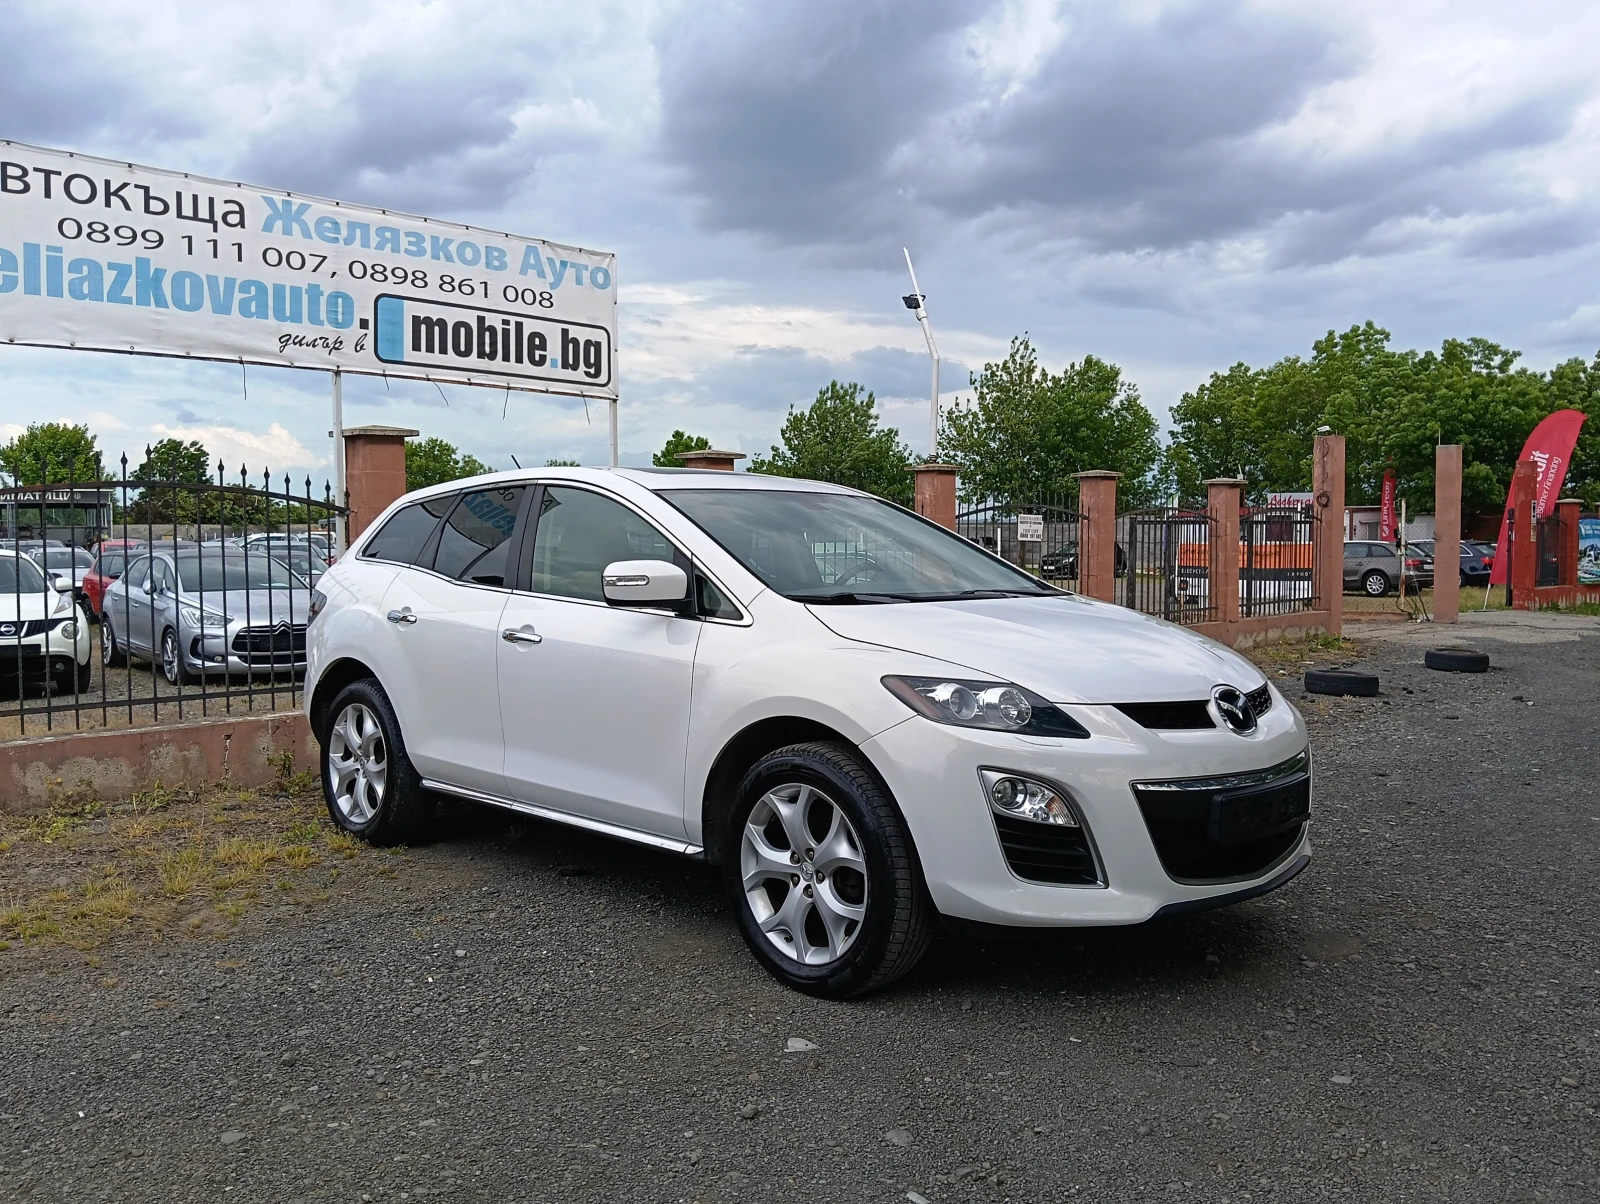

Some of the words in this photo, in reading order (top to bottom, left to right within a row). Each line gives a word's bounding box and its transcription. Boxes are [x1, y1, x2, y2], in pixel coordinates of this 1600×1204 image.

[57, 217, 164, 250] 0899
[181, 235, 243, 262] 111
[262, 247, 338, 279] 007,
[348, 260, 429, 289] 0898
[438, 274, 489, 298] 861
[503, 285, 555, 309] 008
[260, 195, 508, 272] Желязков
[519, 245, 611, 290] Ауто
[411, 315, 602, 378] mobile.bg
[1543, 456, 1562, 490] Financing
